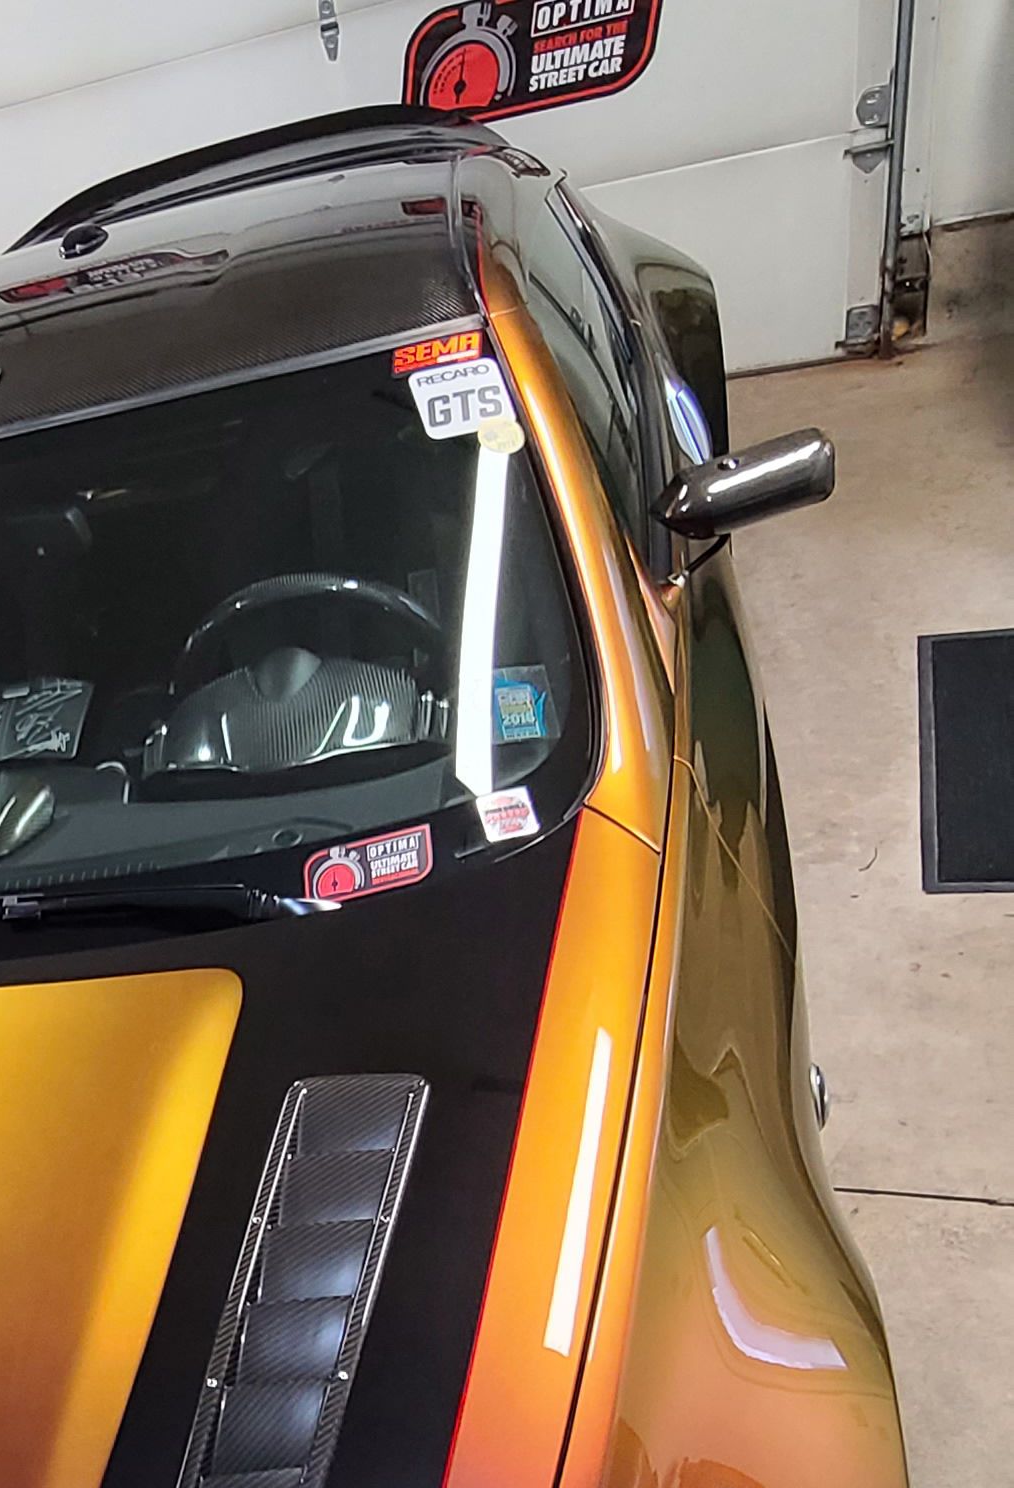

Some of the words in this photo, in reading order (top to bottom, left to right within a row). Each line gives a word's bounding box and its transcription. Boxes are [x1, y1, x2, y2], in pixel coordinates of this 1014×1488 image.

[531, 34, 627, 75] ULTIMATE
[534, 31, 578, 54] SEARCH
[580, 26, 603, 43] FOR
[528, 64, 587, 93] STREET
[587, 56, 623, 79] CAR
[393, 332, 480, 367] SEMA
[416, 364, 490, 388] RECARO
[427, 385, 503, 428] GTS
[369, 836, 417, 859] OPTIMA
